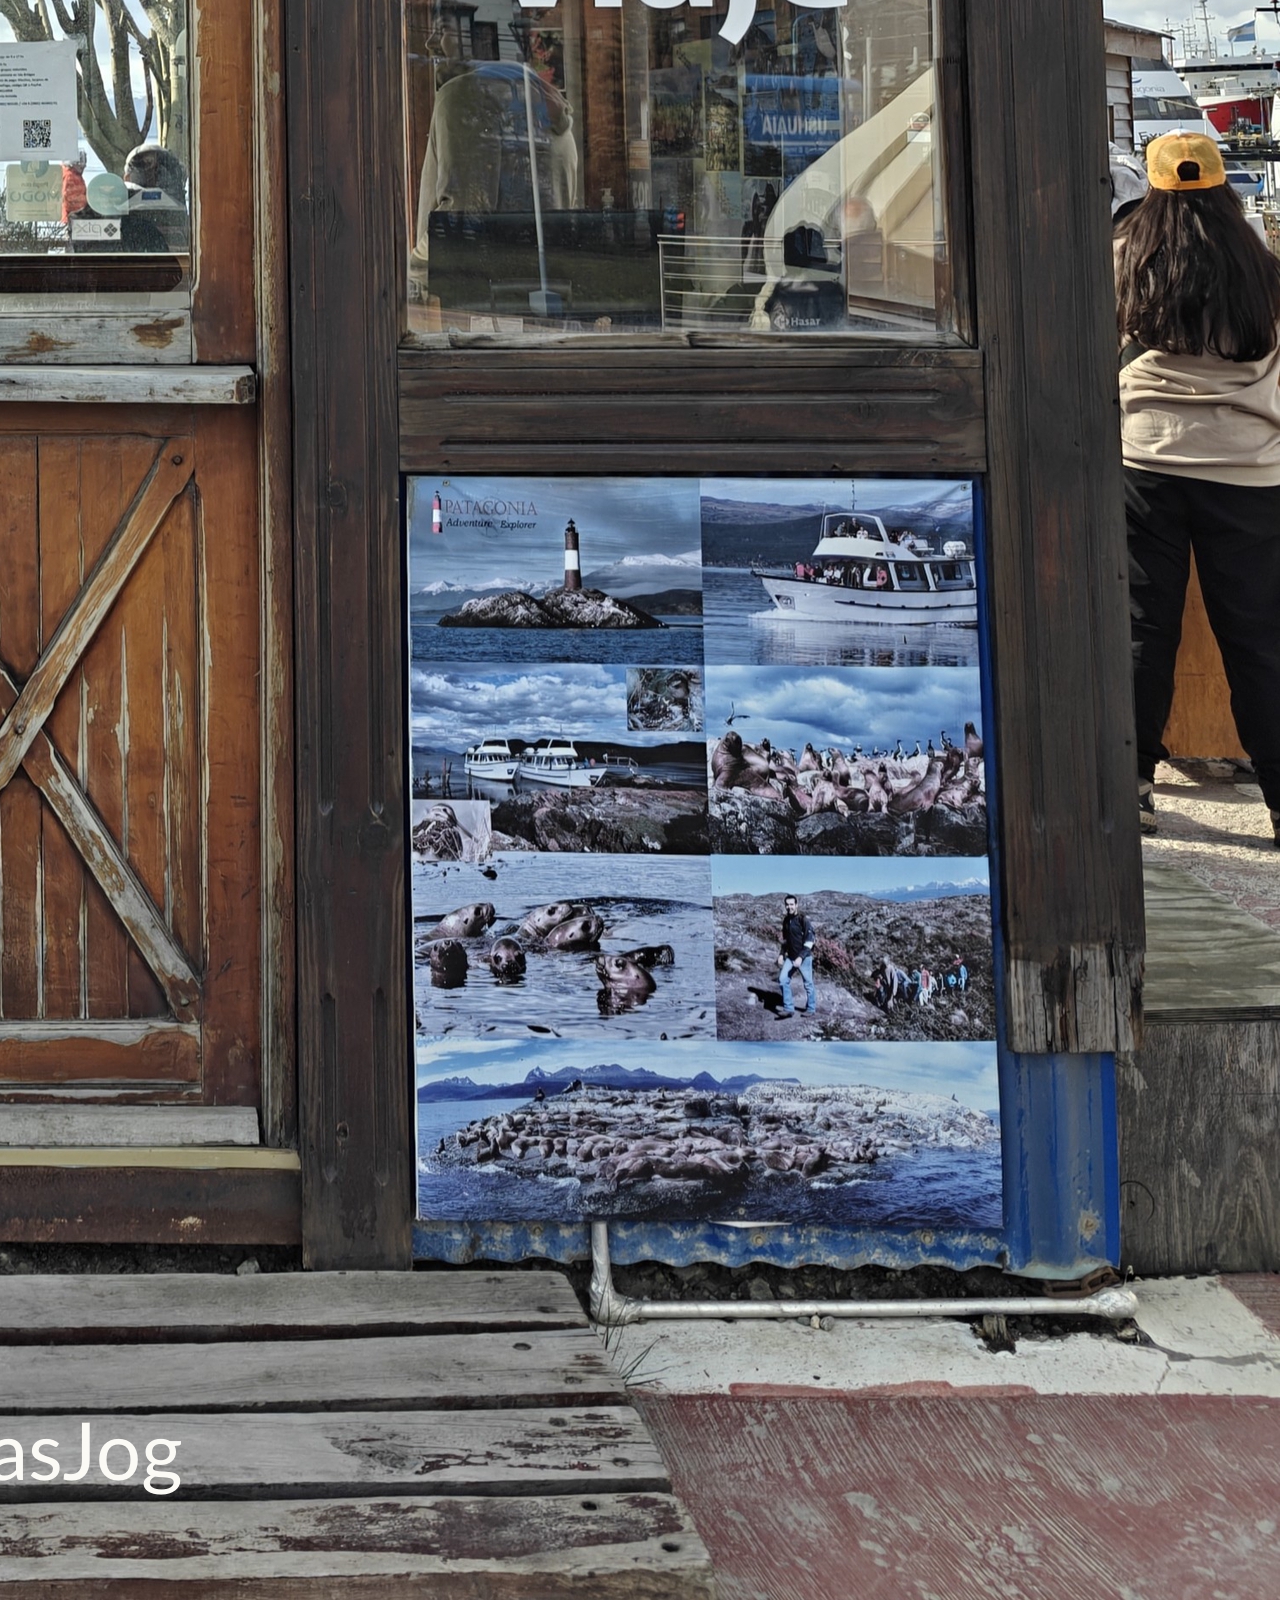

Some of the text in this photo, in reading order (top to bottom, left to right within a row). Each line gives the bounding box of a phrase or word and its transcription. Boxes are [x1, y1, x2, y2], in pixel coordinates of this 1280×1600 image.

[791, 316, 821, 327] Hasar
[445, 499, 538, 516] PATAGONIA
[446, 518, 537, 531] Adventure Explorer
